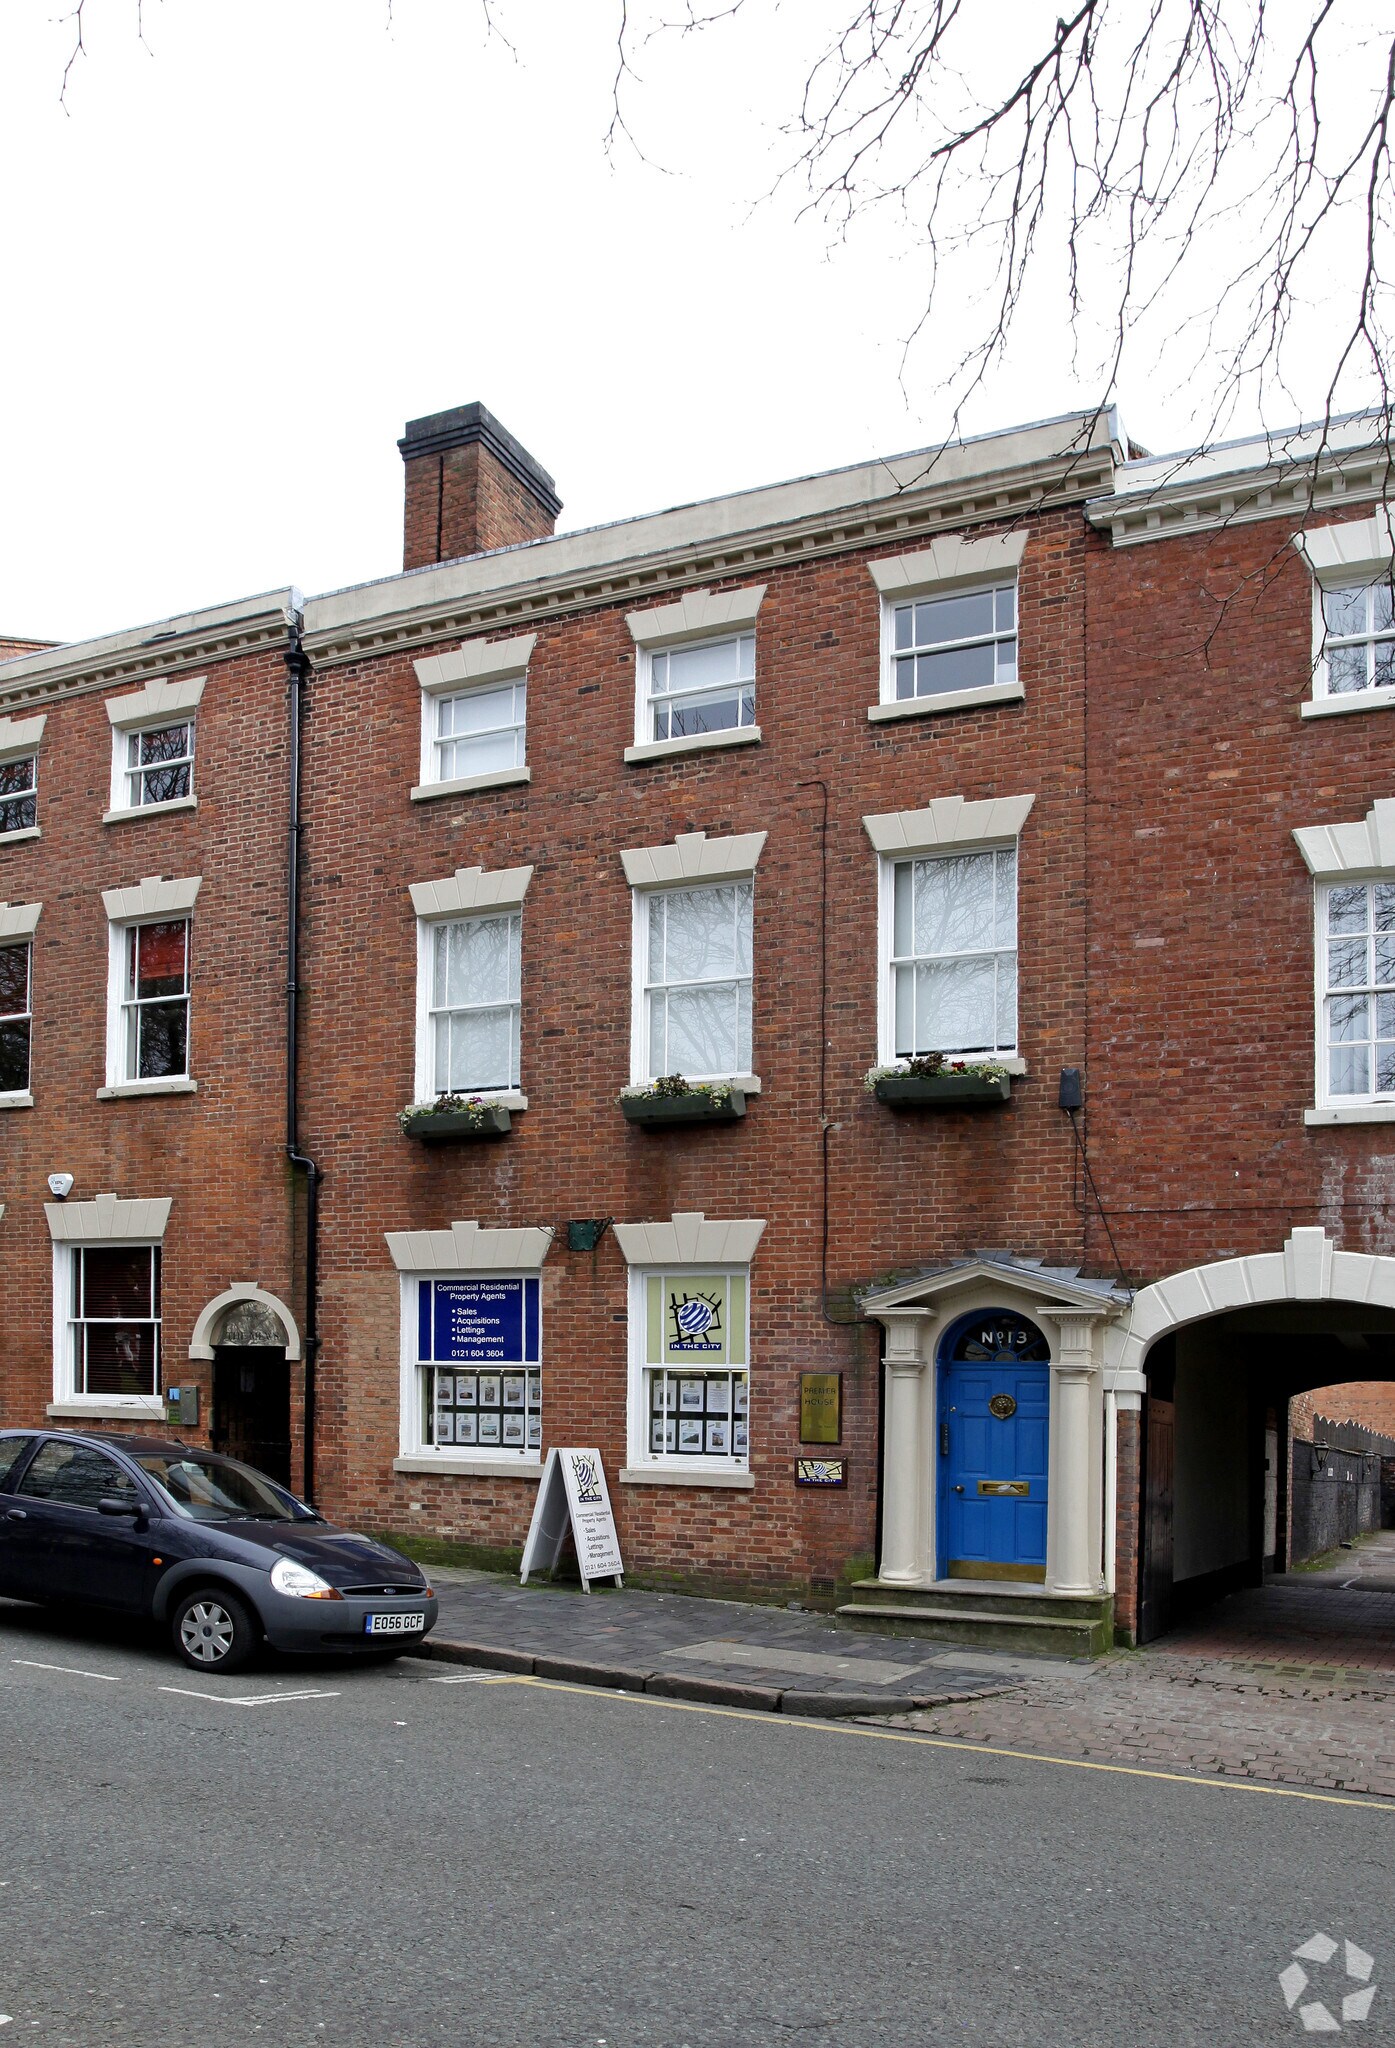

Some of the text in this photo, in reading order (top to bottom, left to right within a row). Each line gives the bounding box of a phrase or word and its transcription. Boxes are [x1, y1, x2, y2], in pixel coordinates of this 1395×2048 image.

[437, 1283, 520, 1292] Commercial Residential
[450, 1292, 506, 1301] Property Agents
[457, 1317, 500, 1325] Acquisitions
[457, 1326, 485, 1335] Lettings
[457, 1335, 504, 1344] Management
[804, 1398, 835, 1406] HOUSE
[587, 1534, 610, 1542] Acquisitions
[590, 1550, 614, 1558] Management
[403, 1615, 423, 1629] GCF
